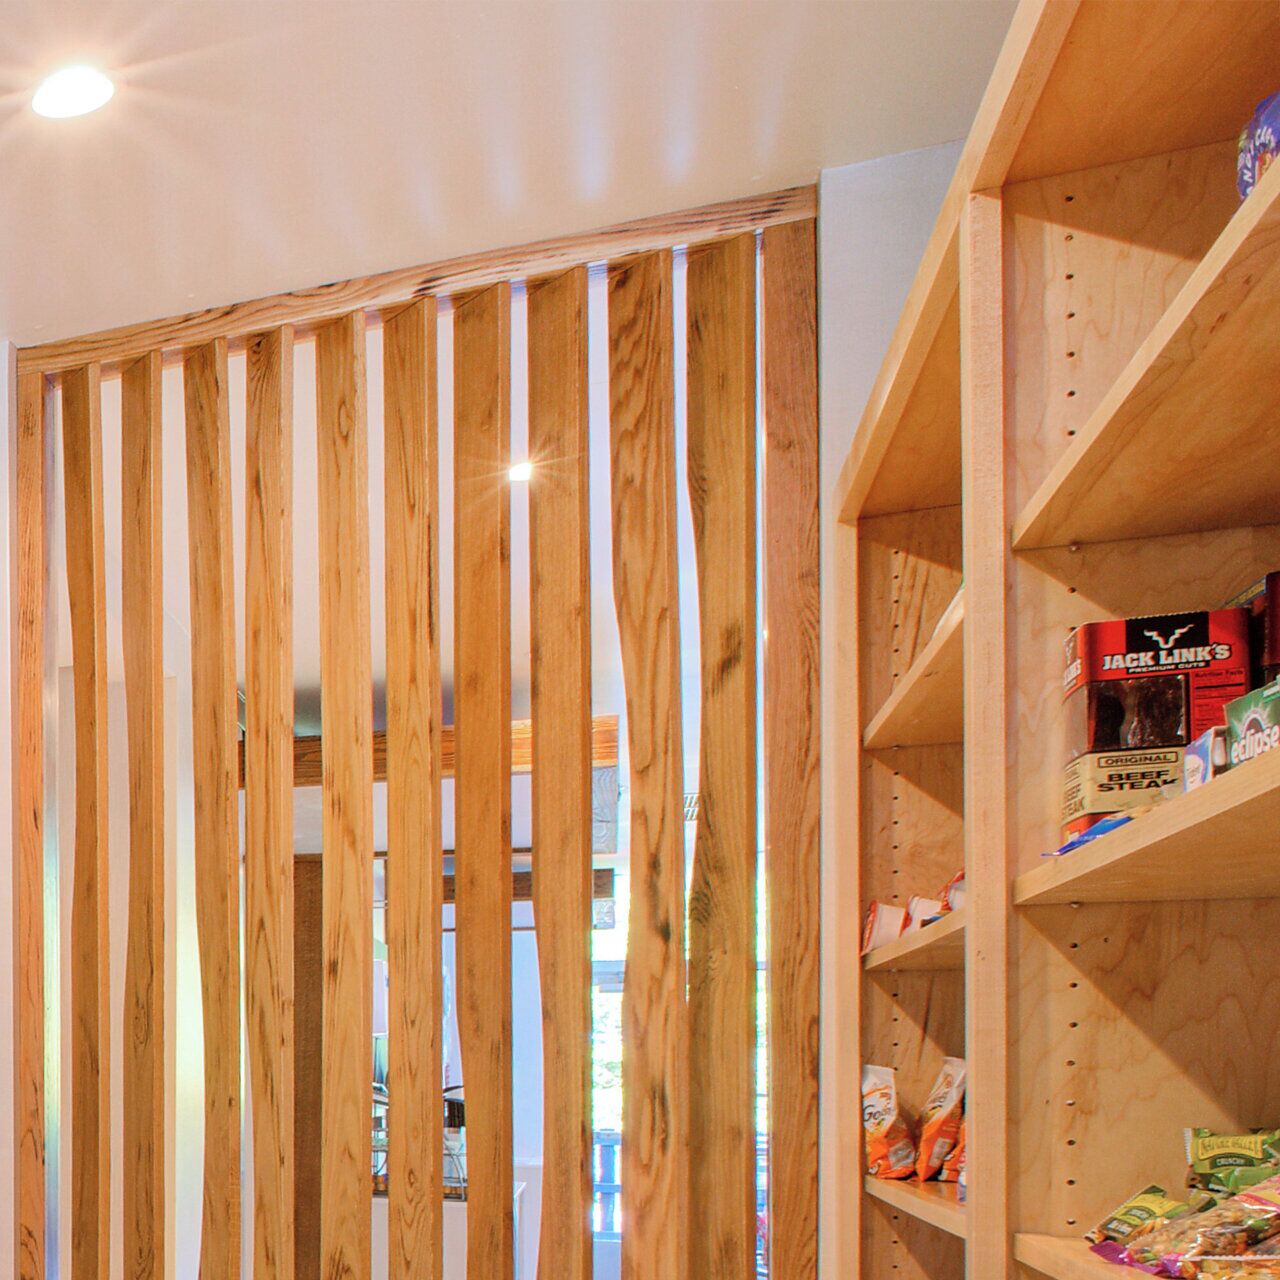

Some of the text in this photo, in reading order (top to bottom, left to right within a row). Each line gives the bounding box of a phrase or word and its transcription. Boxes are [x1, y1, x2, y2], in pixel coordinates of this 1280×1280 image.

[1103, 643, 1231, 671] JACK LINK'S
[1128, 661, 1207, 674] PREMIUM CUTS
[1230, 725, 1280, 765] eclipse
[1104, 754, 1172, 766] ORIGINAL
[1108, 770, 1170, 783] BEEF
